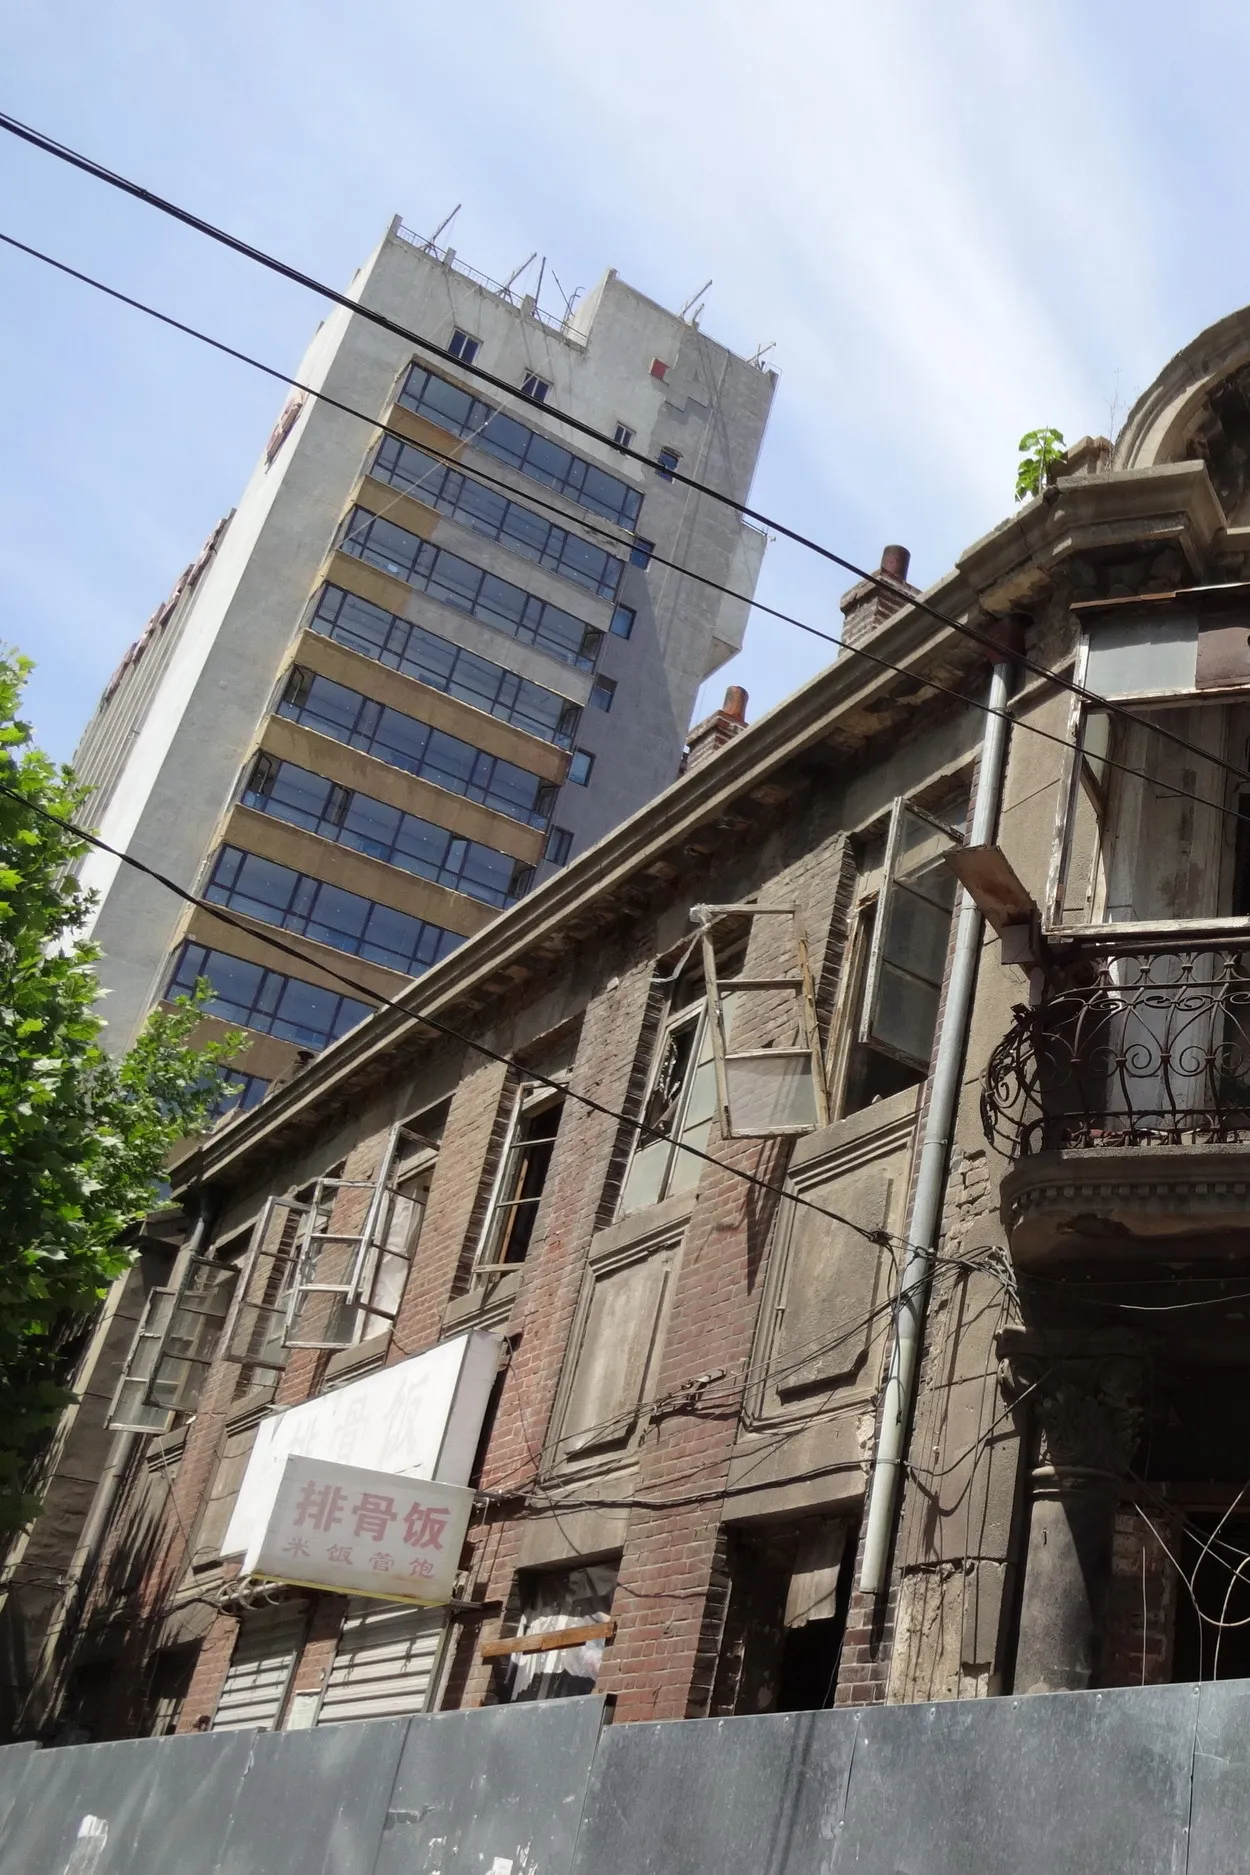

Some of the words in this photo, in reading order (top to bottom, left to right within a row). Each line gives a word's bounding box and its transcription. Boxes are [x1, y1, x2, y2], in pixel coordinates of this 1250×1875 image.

[293, 1480, 451, 1551] 排骨饭
[283, 1536, 436, 1580] 米饭管饱
